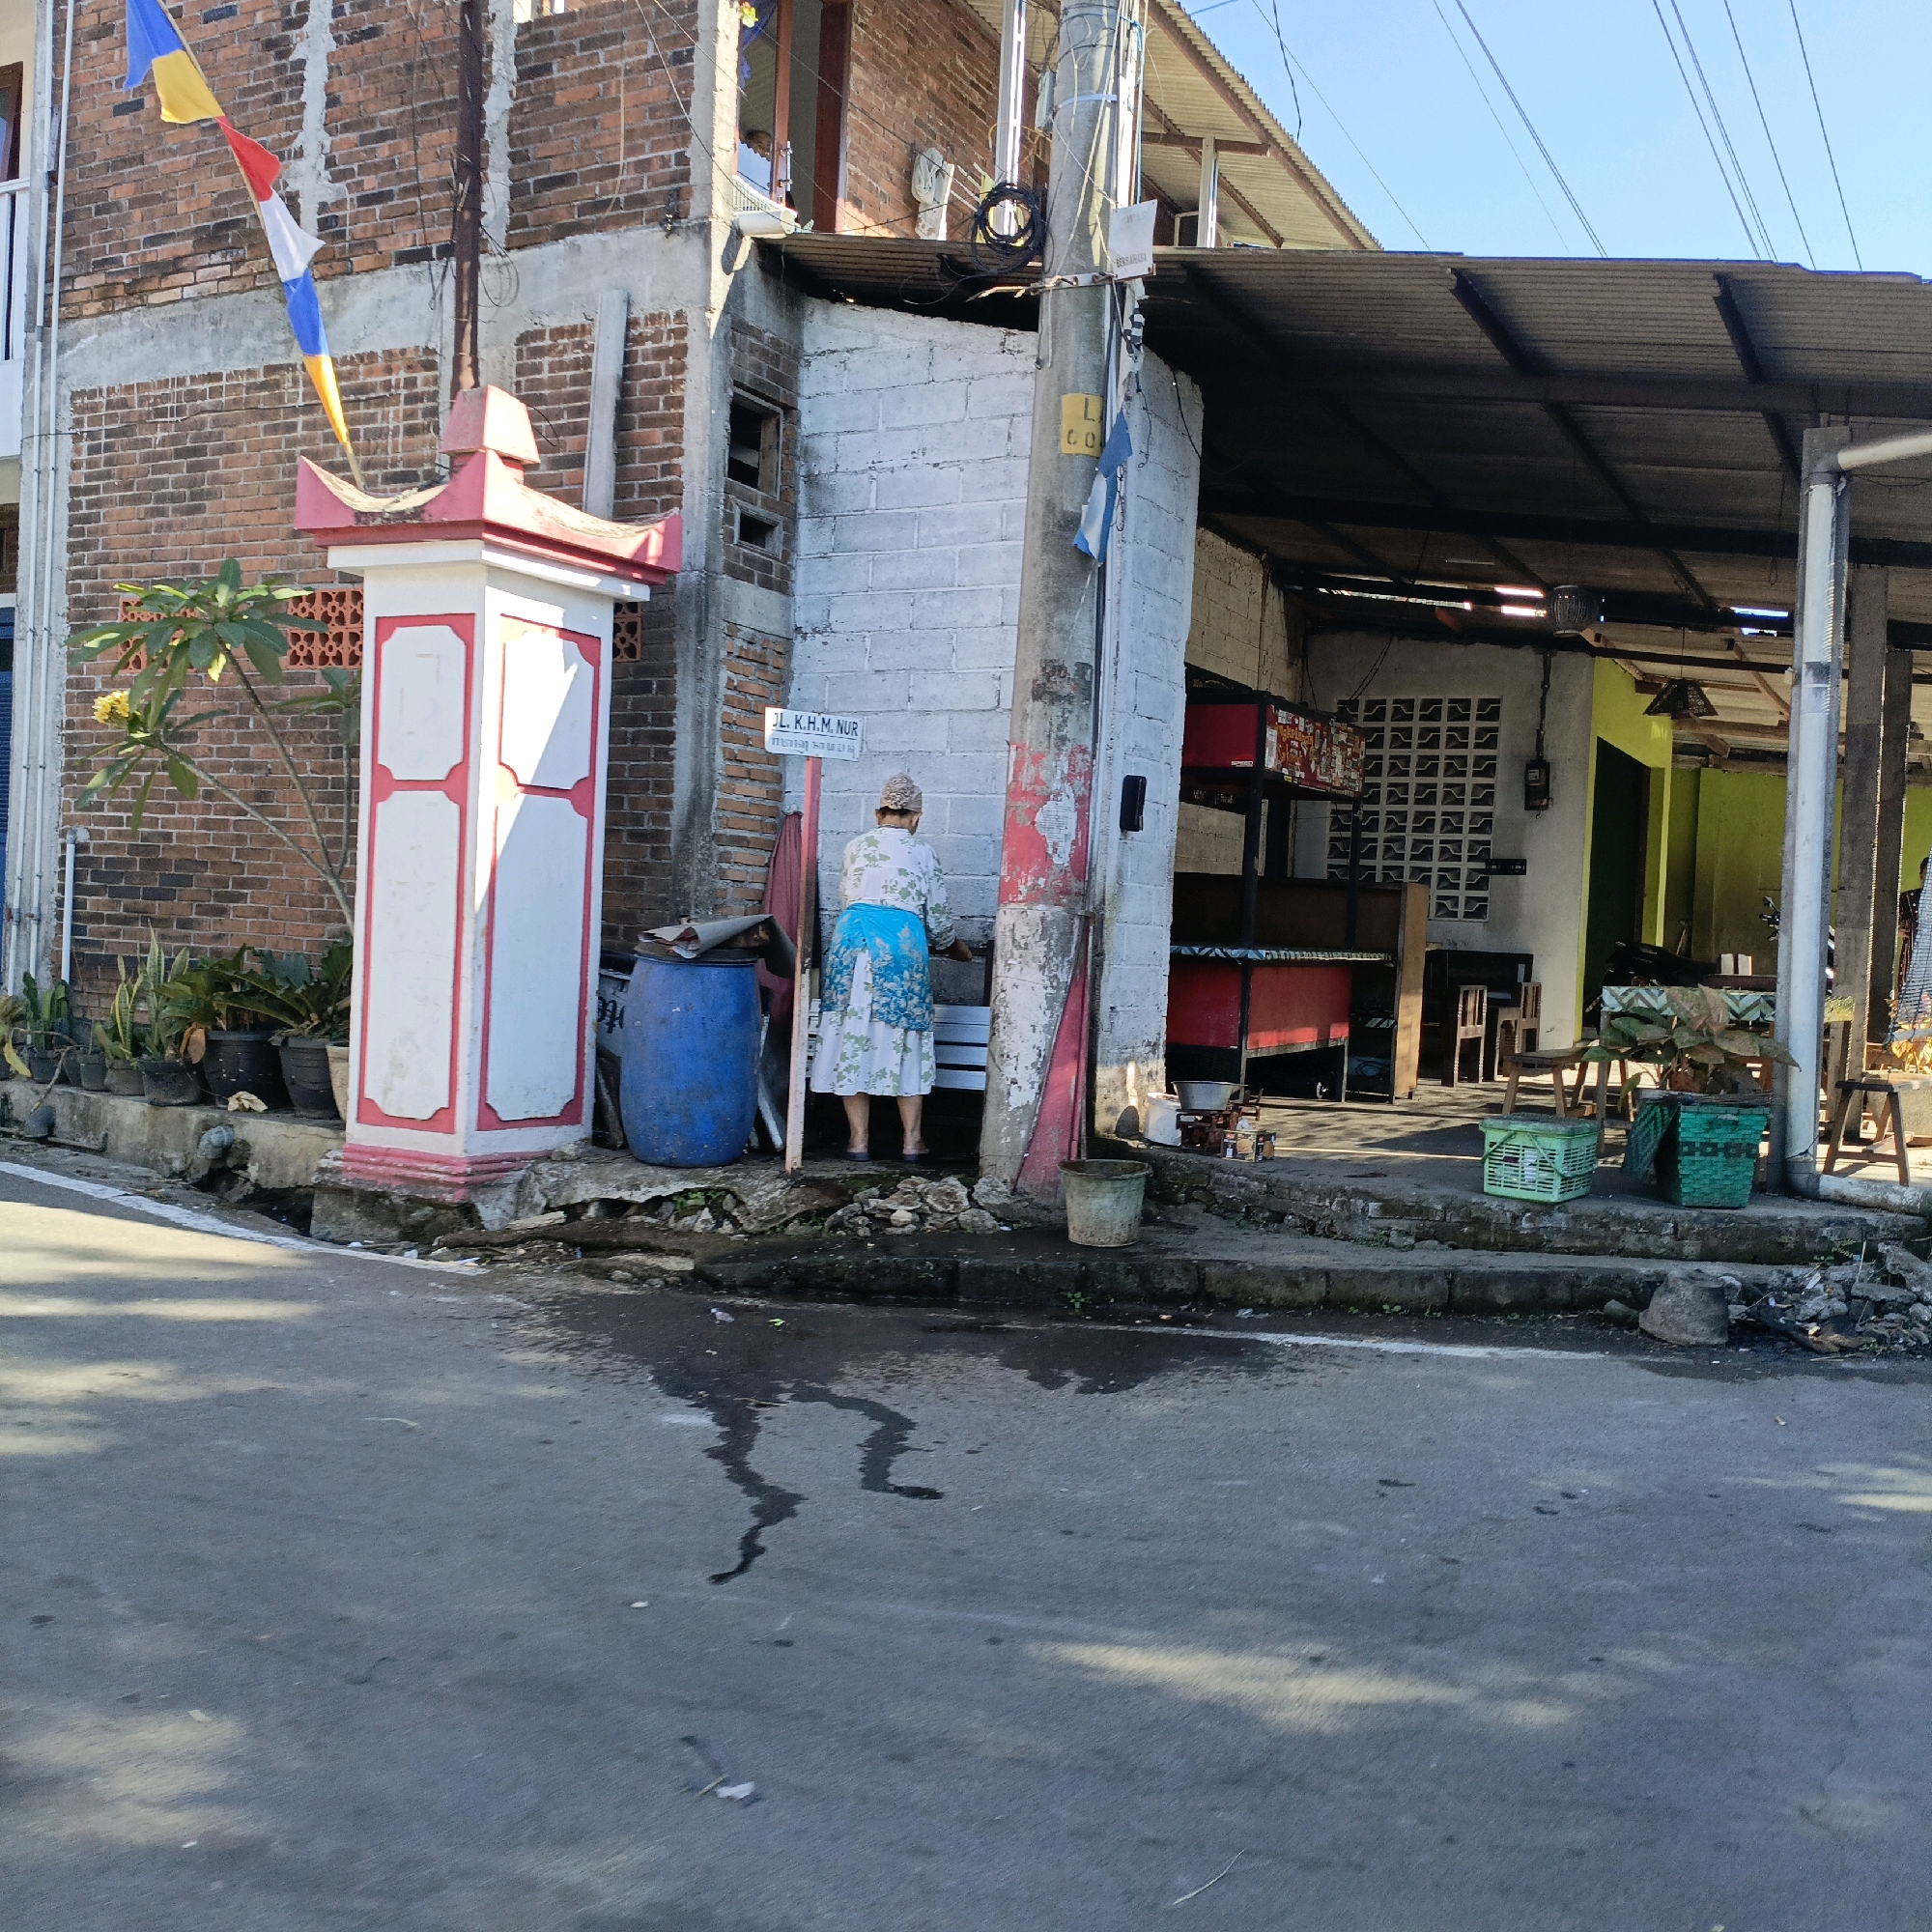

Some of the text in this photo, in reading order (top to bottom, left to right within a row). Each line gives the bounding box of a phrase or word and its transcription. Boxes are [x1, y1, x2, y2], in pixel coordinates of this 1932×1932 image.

[772, 713, 859, 737] JL. K.H.M. NUR
